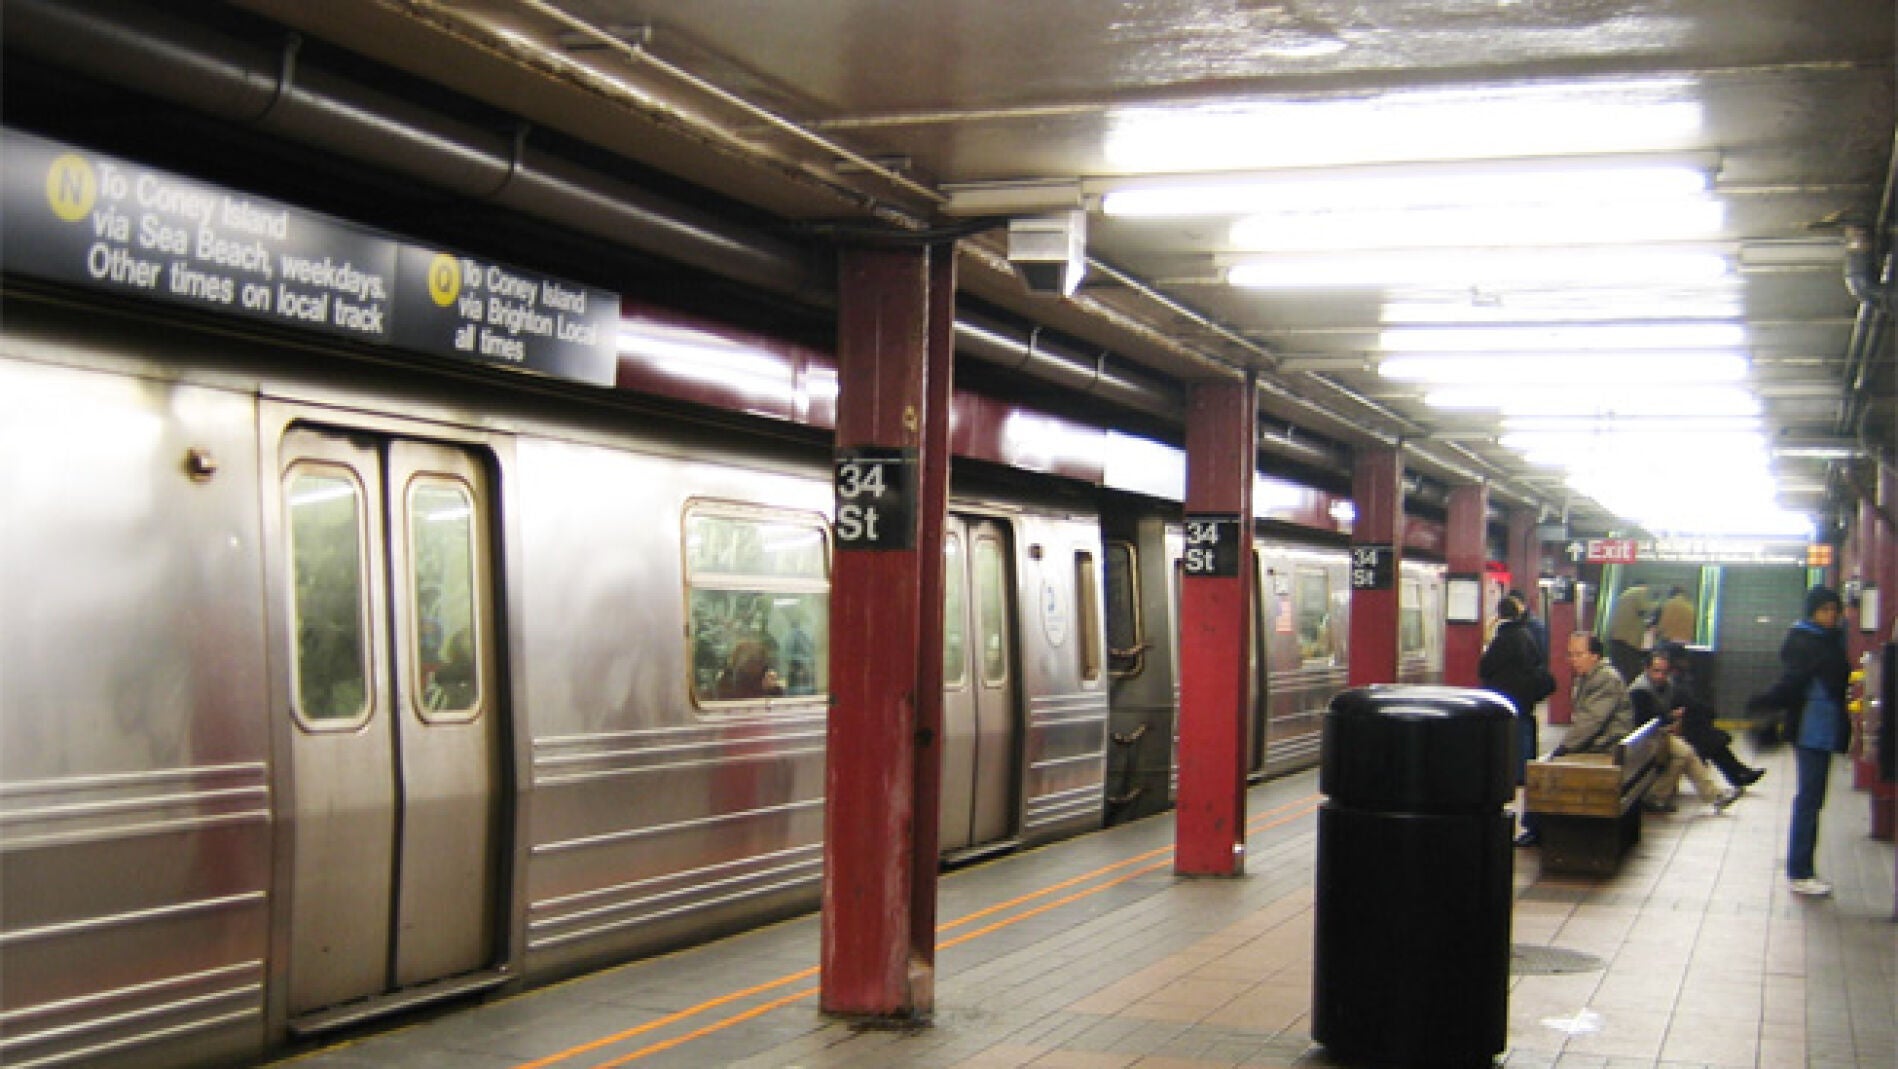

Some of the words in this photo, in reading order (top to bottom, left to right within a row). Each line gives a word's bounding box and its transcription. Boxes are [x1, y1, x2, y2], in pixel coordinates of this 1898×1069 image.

[98, 162, 127, 201] To
[136, 175, 217, 226] Coney
[221, 197, 289, 238] Island
[93, 207, 130, 241] via
[139, 214, 188, 254] Sea
[196, 224, 273, 280] Beach,
[88, 243, 161, 289] Other
[169, 260, 235, 305] times
[241, 282, 270, 311] on
[277, 283, 328, 322] local
[335, 297, 385, 334] track
[463, 260, 482, 288] To
[487, 265, 538, 307] Coney
[543, 280, 586, 314] Island
[459, 291, 483, 322] via
[487, 297, 553, 335] Brighton
[455, 323, 476, 351] all
[480, 328, 526, 362] times
[837, 463, 886, 499] 34
[837, 504, 879, 541] St
[1185, 522, 1219, 544] 34
[1185, 548, 1215, 571] St
[1354, 548, 1378, 567] 34
[1587, 540, 1631, 560] Exit
[1354, 569, 1375, 587] St
